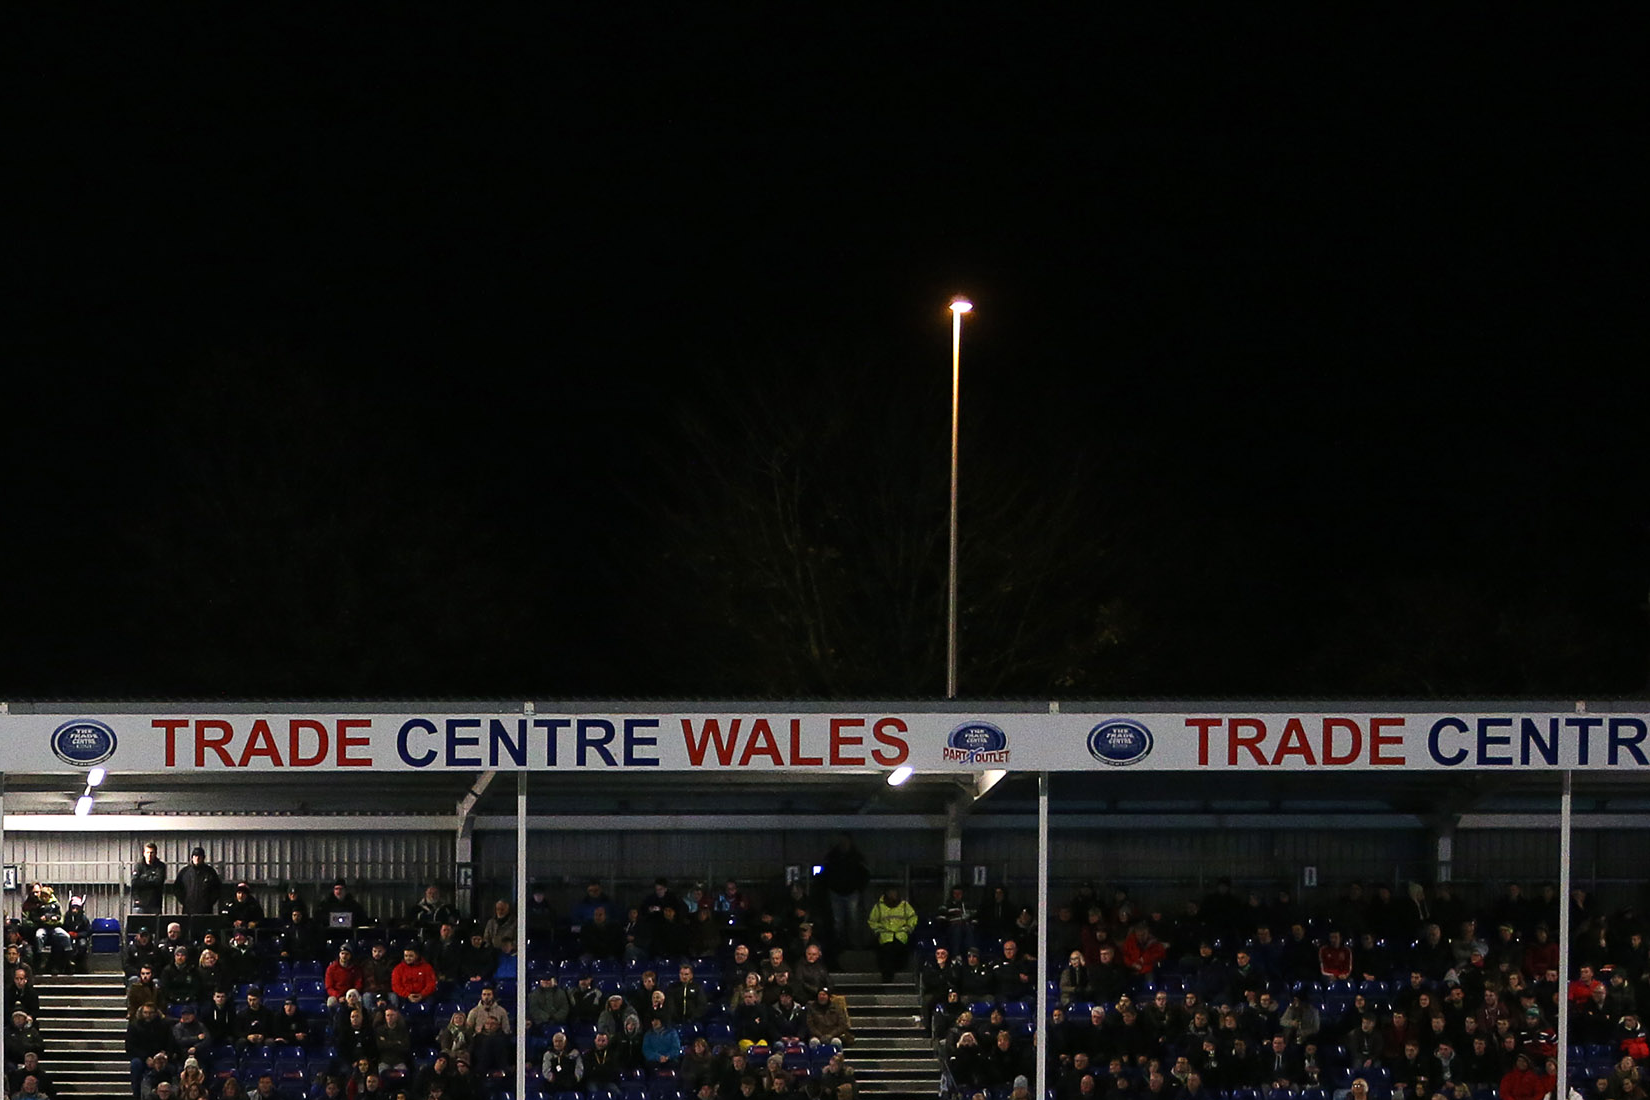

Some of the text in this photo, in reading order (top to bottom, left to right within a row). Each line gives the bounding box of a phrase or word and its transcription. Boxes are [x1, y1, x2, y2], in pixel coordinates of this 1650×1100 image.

[151, 719, 910, 768] TRADE CENTRE WALES
[1185, 717, 1650, 766] TRADE CENTR
